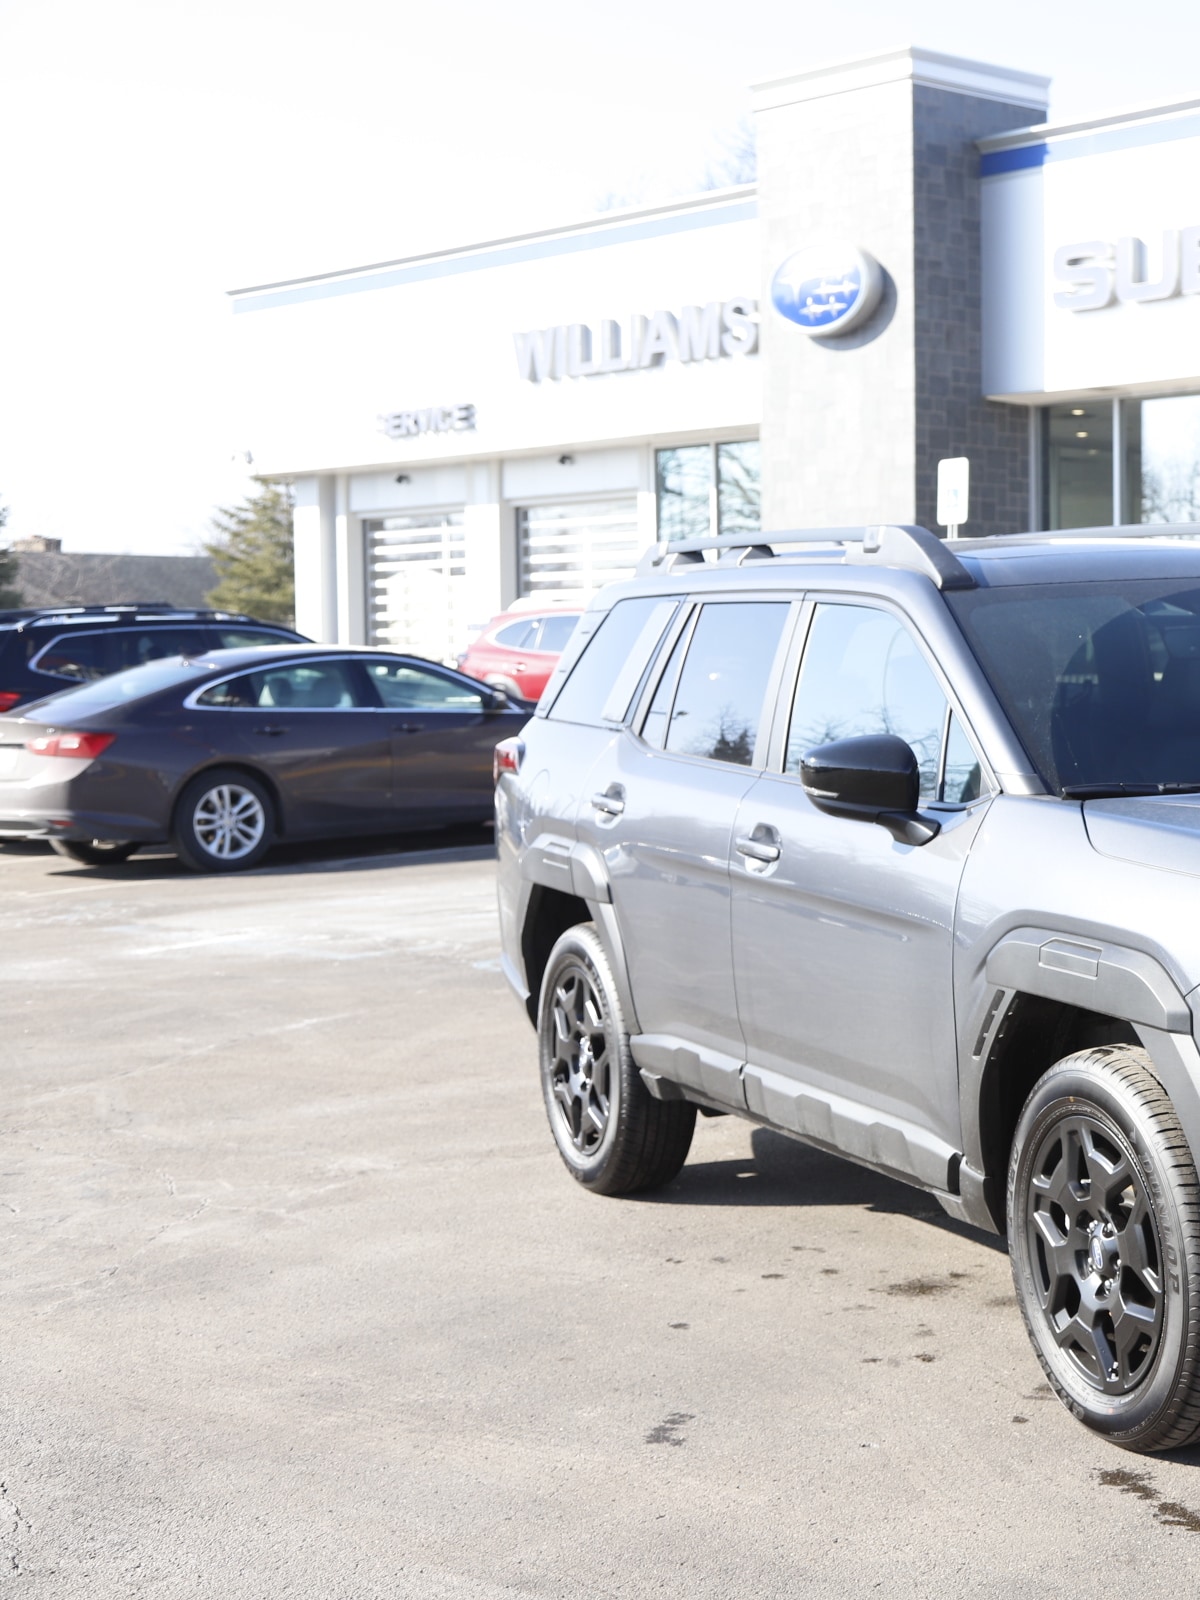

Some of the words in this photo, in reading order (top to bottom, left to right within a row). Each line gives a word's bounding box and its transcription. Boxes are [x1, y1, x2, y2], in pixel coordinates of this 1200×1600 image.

[512, 296, 759, 383] WILLIAMS
[376, 403, 476, 439] SERVICE
[1138, 1151, 1180, 1295] DUNLOP
